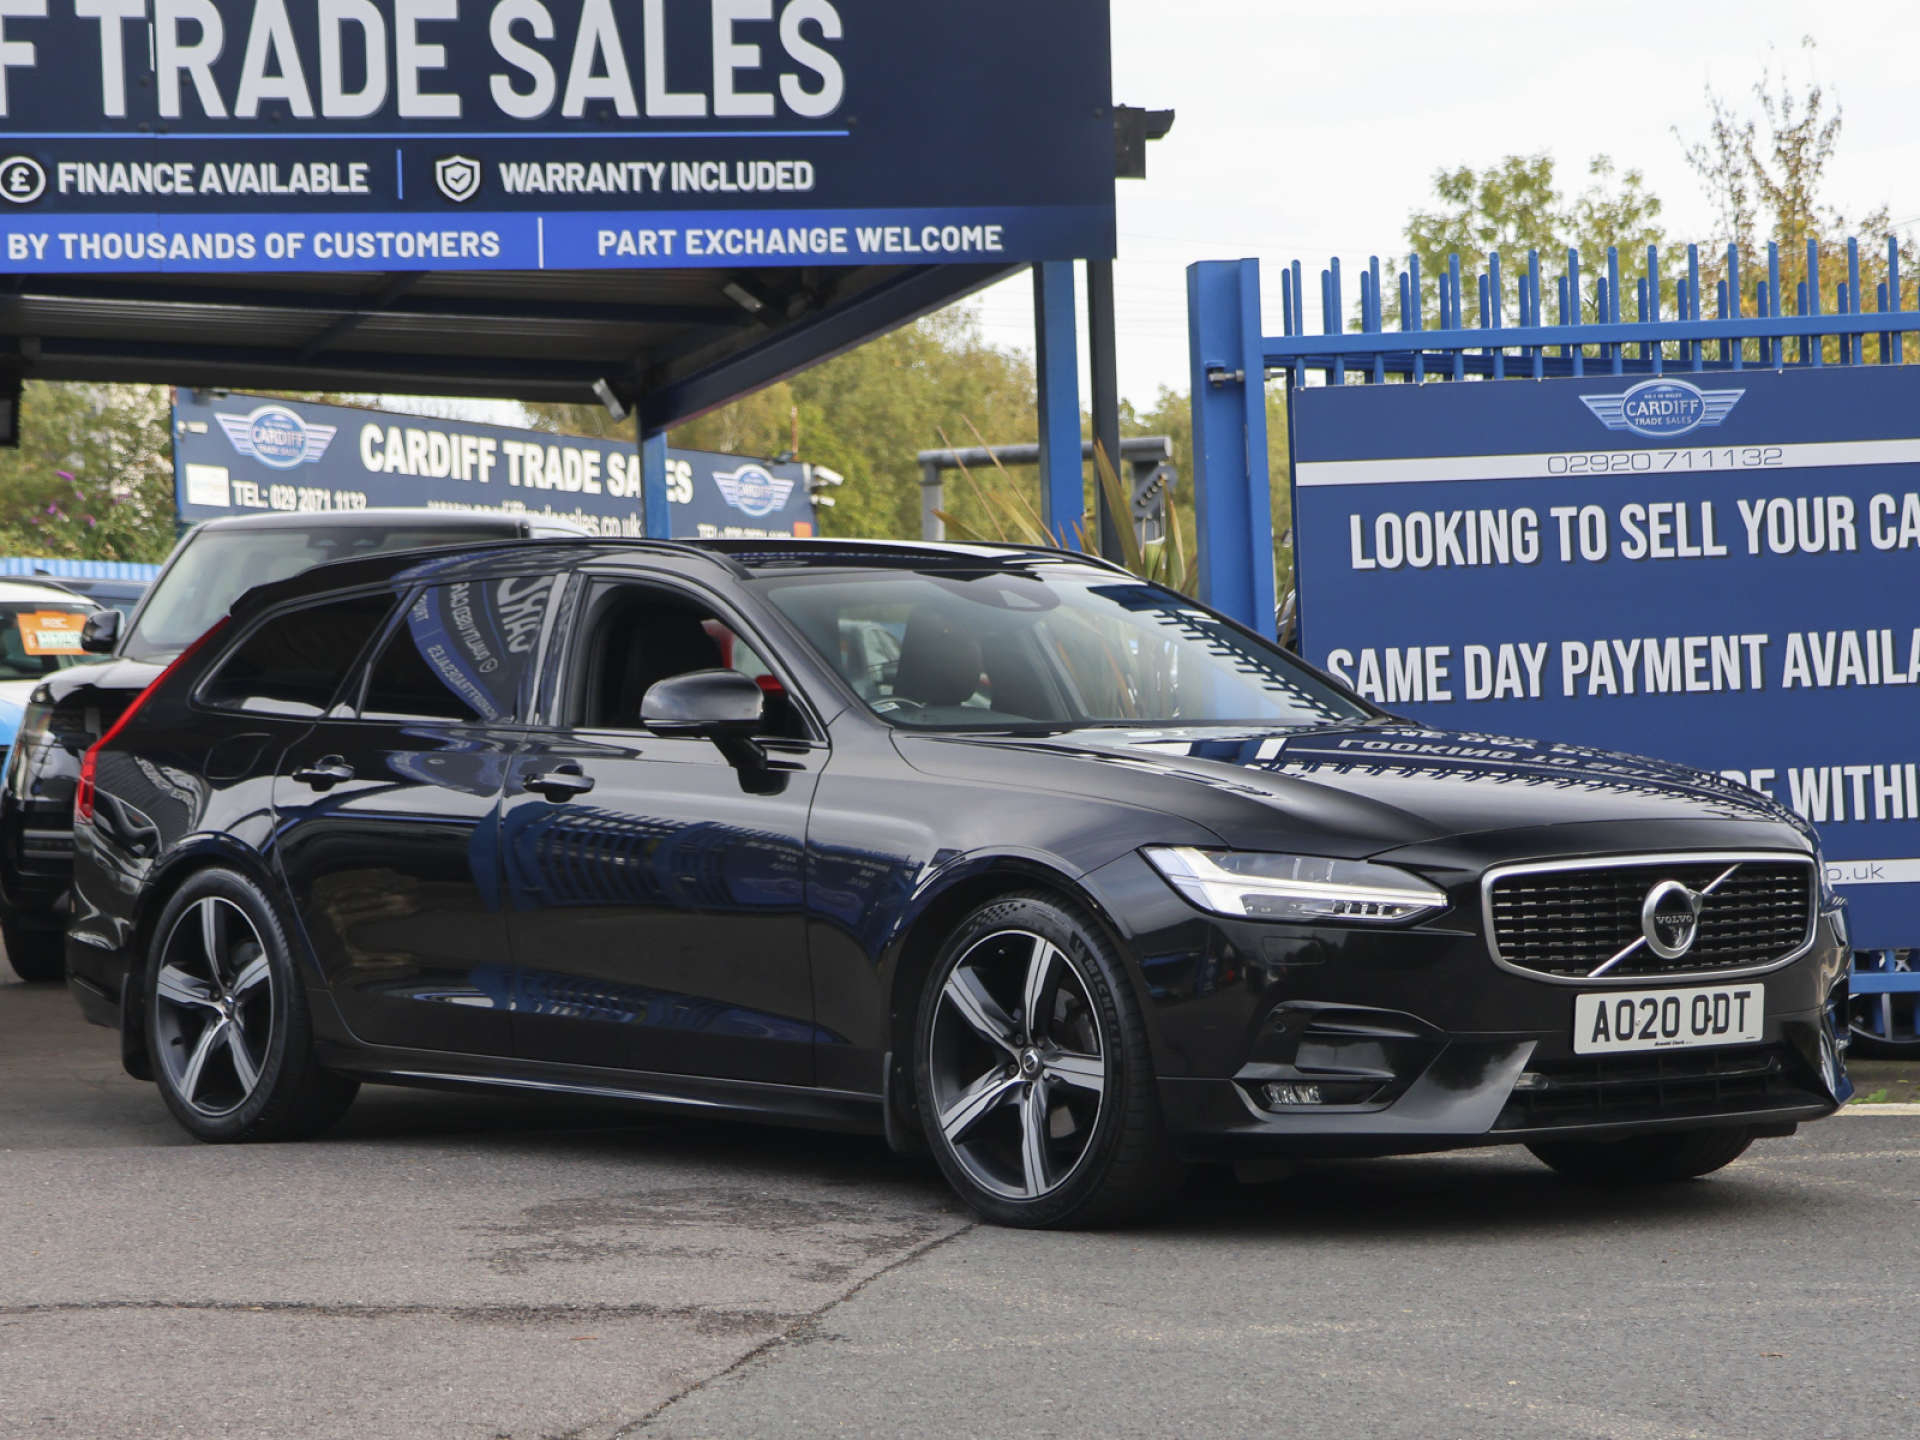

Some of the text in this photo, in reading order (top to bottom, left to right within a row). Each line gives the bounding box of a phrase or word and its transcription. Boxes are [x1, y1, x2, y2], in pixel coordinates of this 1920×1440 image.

[76, 0, 463, 118] TRADE
[490, 0, 844, 118] SALES
[58, 162, 194, 194] FINANCE
[199, 162, 369, 193] AVAILABLE
[499, 161, 814, 193] WARRANTY INCLUDED
[8, 231, 500, 260] BY THOUSANDS OF CUSTOMERS
[597, 225, 1003, 256] PART EXCHANGE WELCOME
[1626, 399, 1700, 416] CARDIFF
[1635, 416, 1692, 426] TRADE SALES
[360, 423, 497, 483] CARDIFF
[503, 440, 602, 494] TRADE
[607, 451, 694, 505] SAES
[1547, 447, 1784, 475] 02920 711132
[1349, 507, 1539, 569] LOOKING
[1550, 505, 1607, 561] TO
[1619, 501, 1727, 560] SELL
[1736, 496, 1857, 554] YOUR
[1326, 645, 1453, 703] SAME
[1463, 642, 1548, 700] DAY
[1561, 634, 1769, 696] PAYMENT
[1787, 763, 1918, 823] WITHI
[1655, 913, 1694, 925] VOLVO
[1590, 990, 1752, 1044] AO20 ODT
